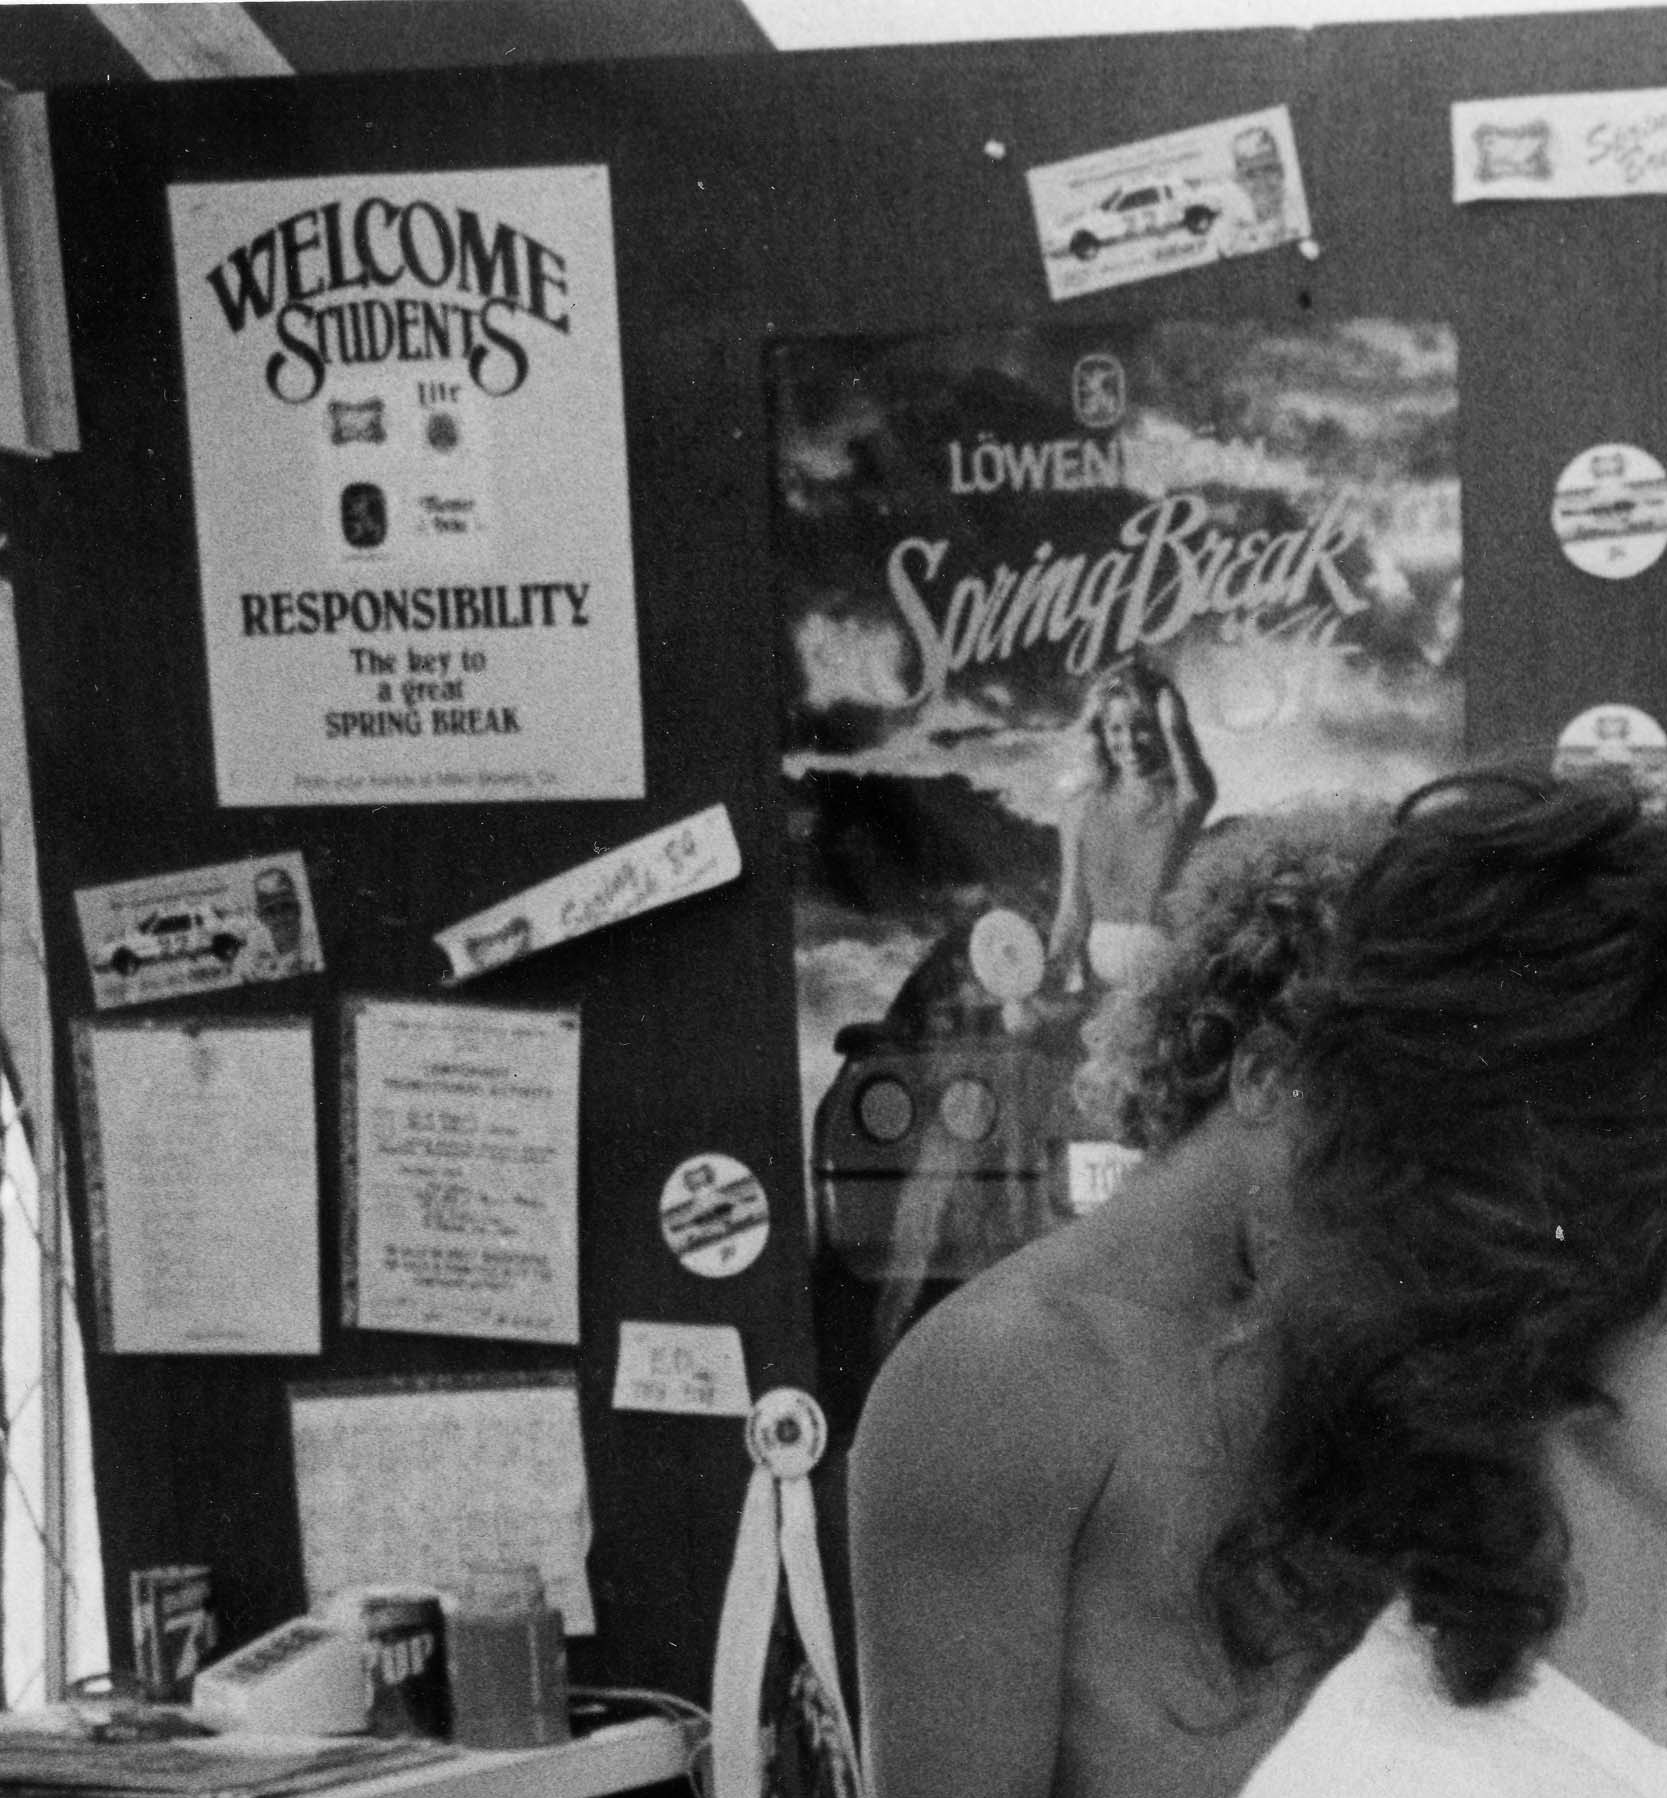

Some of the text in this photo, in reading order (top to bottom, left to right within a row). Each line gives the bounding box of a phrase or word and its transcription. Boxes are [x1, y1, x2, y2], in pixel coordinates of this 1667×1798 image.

[205, 197, 570, 335] WELCOME
[265, 298, 529, 404] STUDENTS
[1116, 484, 1370, 651] Break
[240, 582, 590, 637] RESPONSIBILITY
[349, 646, 488, 680] The key to
[377, 678, 464, 707] a great
[324, 706, 522, 739] SPRING BREAK
